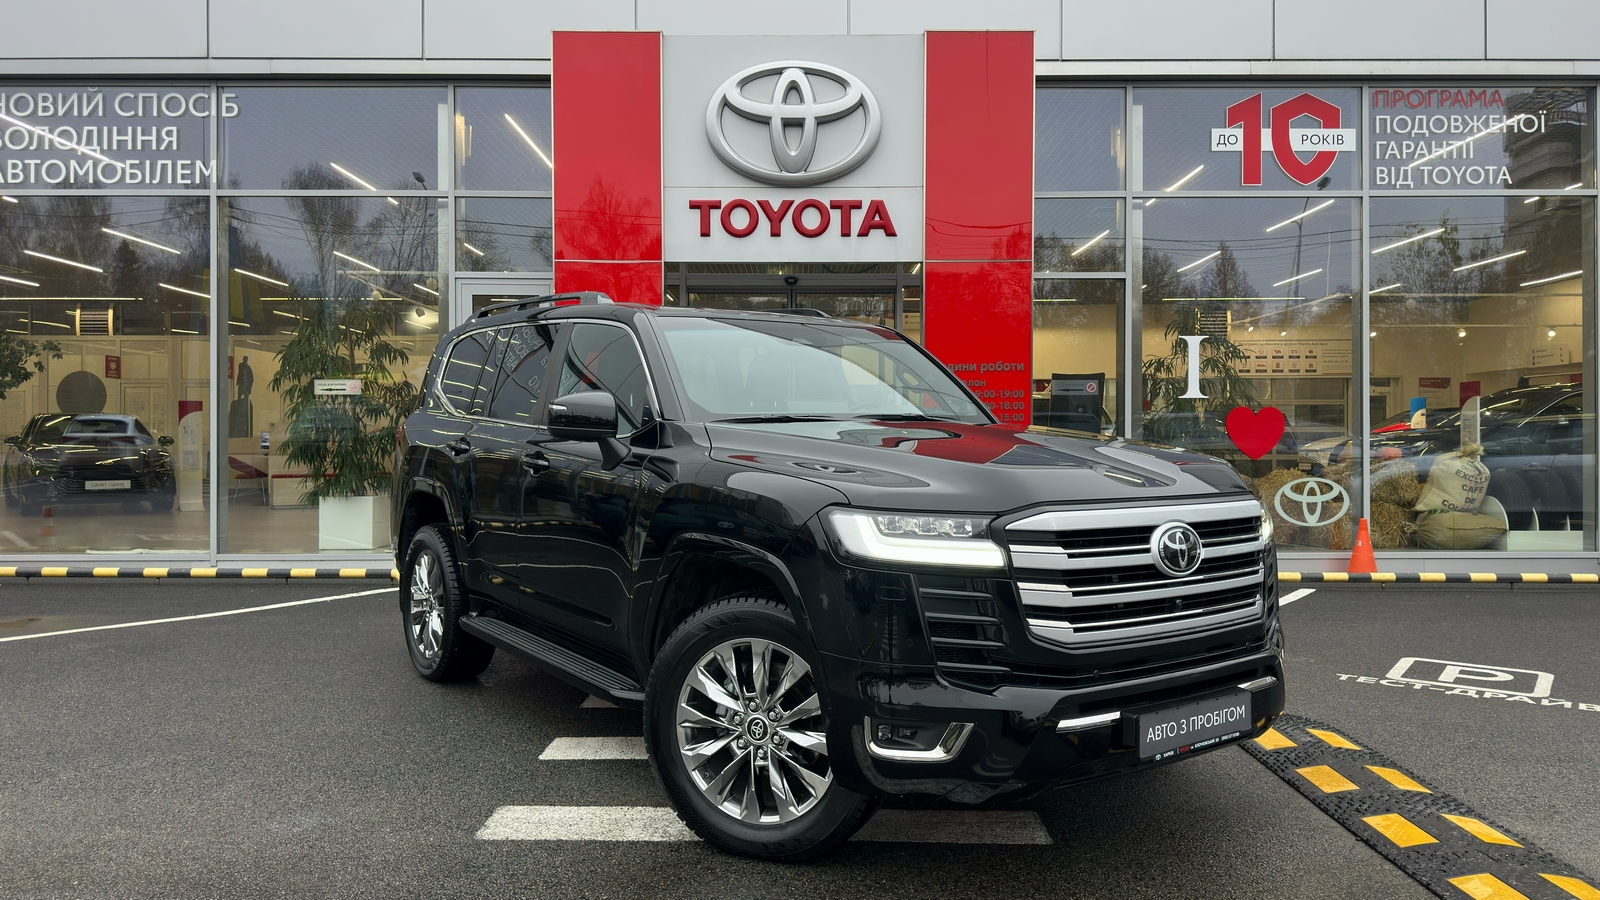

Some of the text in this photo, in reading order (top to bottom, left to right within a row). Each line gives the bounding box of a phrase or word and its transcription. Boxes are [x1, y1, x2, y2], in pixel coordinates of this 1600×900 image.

[0, 87, 239, 118] ОВИЙ СПОСІБ
[1375, 90, 1505, 108] ПРОГРАМА
[1375, 111, 1547, 137] ПОДОВЖЕНОЇ
[0, 126, 178, 155] ОЛОДІННЯ
[1216, 133, 1239, 149] ДО
[1300, 134, 1345, 147] РОКІВ
[1375, 137, 1474, 159] ГАРАНТІЇ
[0, 160, 217, 184] ВТОМОБІЛЕМ
[1376, 166, 1512, 188] ВІД TOYOTA
[689, 198, 898, 238] TOYOTA
[980, 361, 1025, 373] роботи
[1336, 673, 1600, 712] ТЕСТ-ДРАЙВ
[1146, 721, 1178, 743] АВТО
[1189, 704, 1246, 732] ПРОБІГОМ
